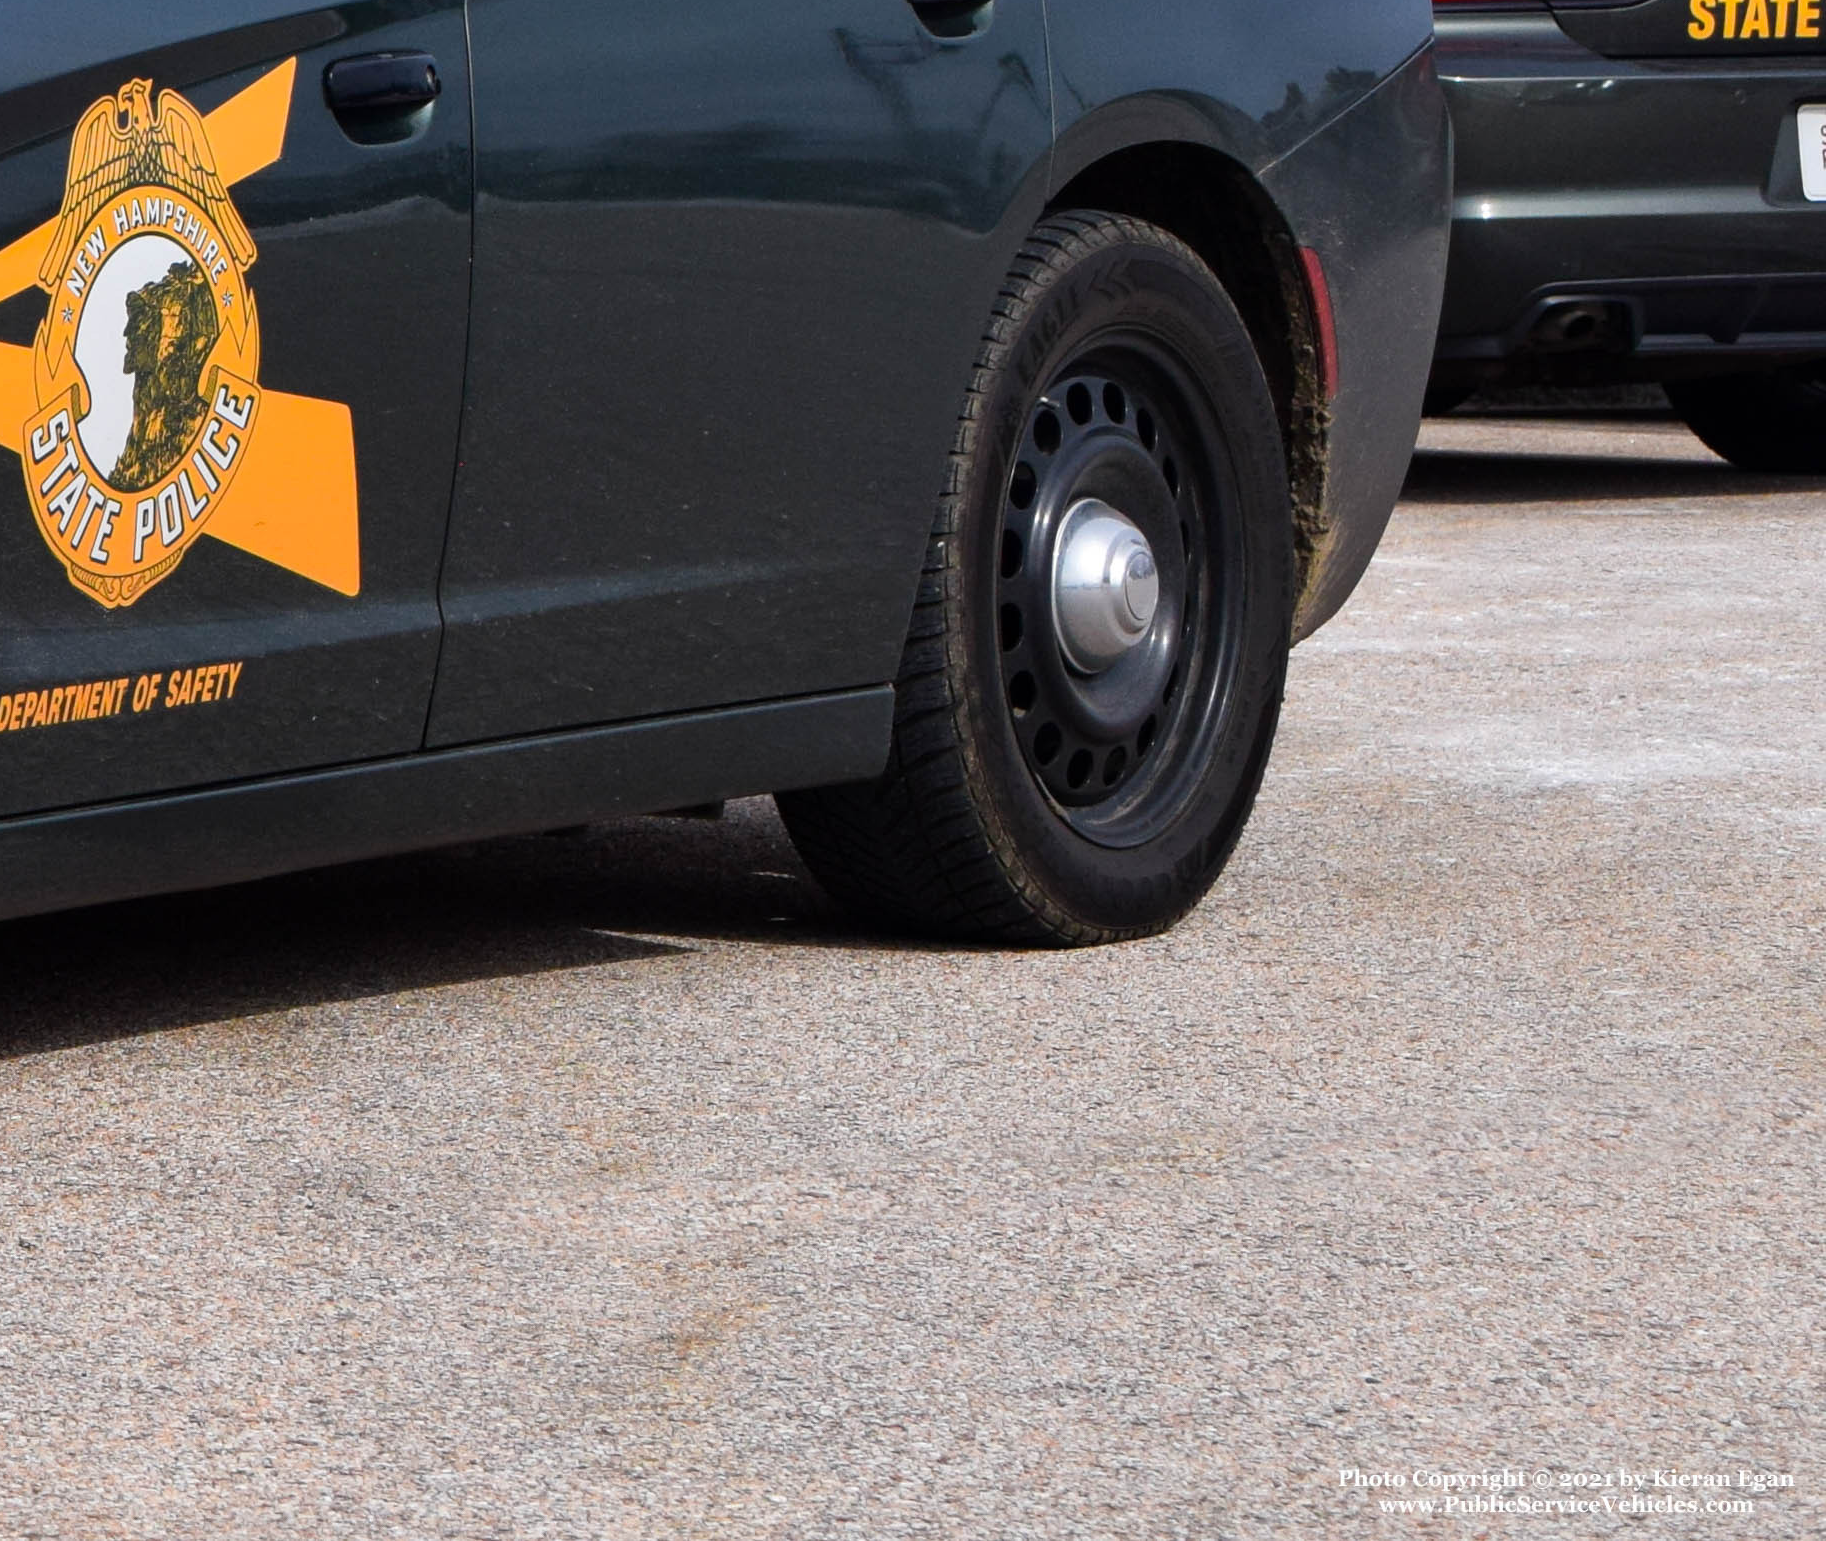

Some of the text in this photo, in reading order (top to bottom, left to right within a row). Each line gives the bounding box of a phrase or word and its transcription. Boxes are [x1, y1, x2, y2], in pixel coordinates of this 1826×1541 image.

[66, 197, 228, 298] NEW HAMPSHIRE
[31, 384, 255, 564] STATE POLICE
[133, 673, 162, 713] OF
[165, 662, 243, 708] SAFETY
